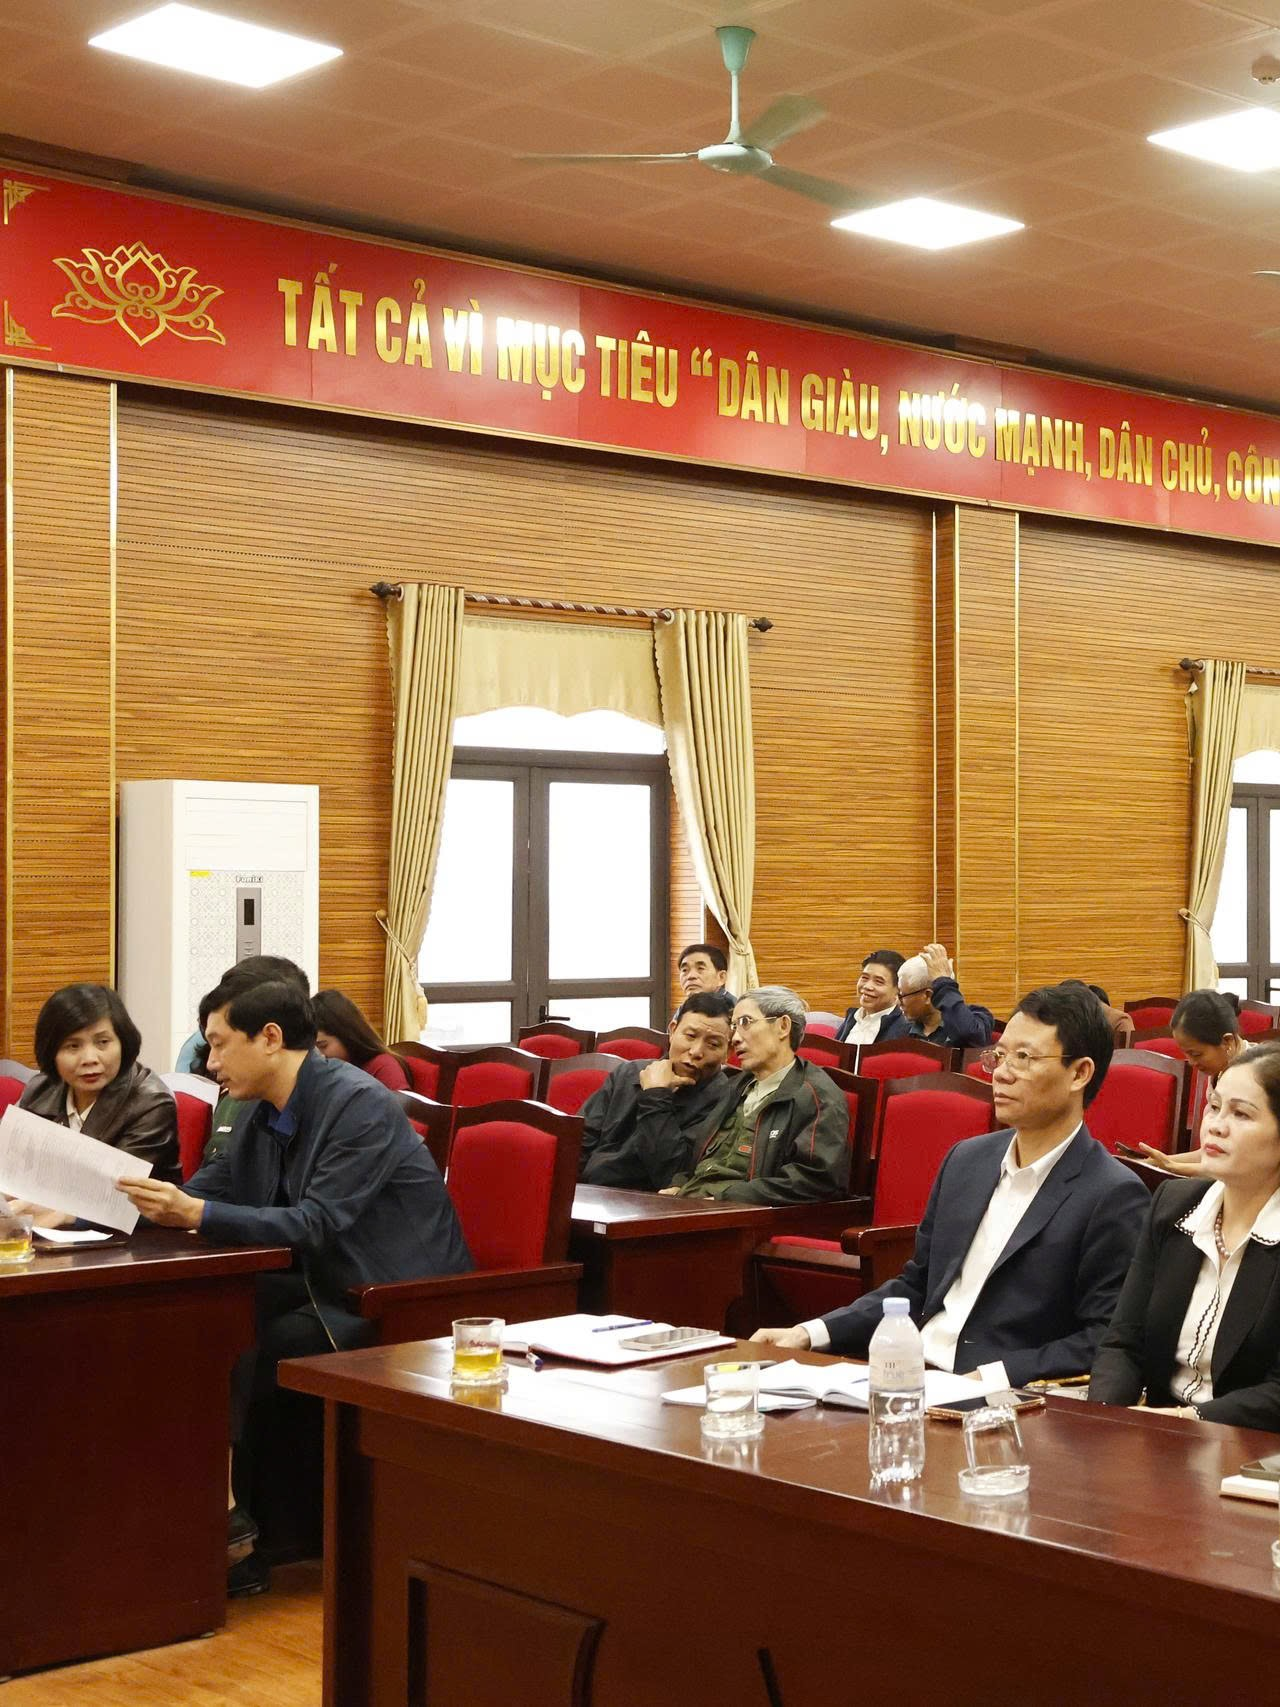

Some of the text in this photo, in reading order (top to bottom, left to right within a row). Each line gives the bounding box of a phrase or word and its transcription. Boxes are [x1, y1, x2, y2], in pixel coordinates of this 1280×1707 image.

[277, 262, 363, 357] TẤT
[375, 278, 433, 369] CẢ
[442, 298, 483, 376] VÌ
[496, 316, 586, 401] MỤC
[595, 330, 679, 408] TIÊU
[801, 367, 889, 456] GIÀU,
[898, 382, 987, 459] NƯỚC
[994, 407, 1092, 477] MẠNH,
[1099, 420, 1153, 486] DÂN
[1161, 426, 1221, 502] CHỦ,
